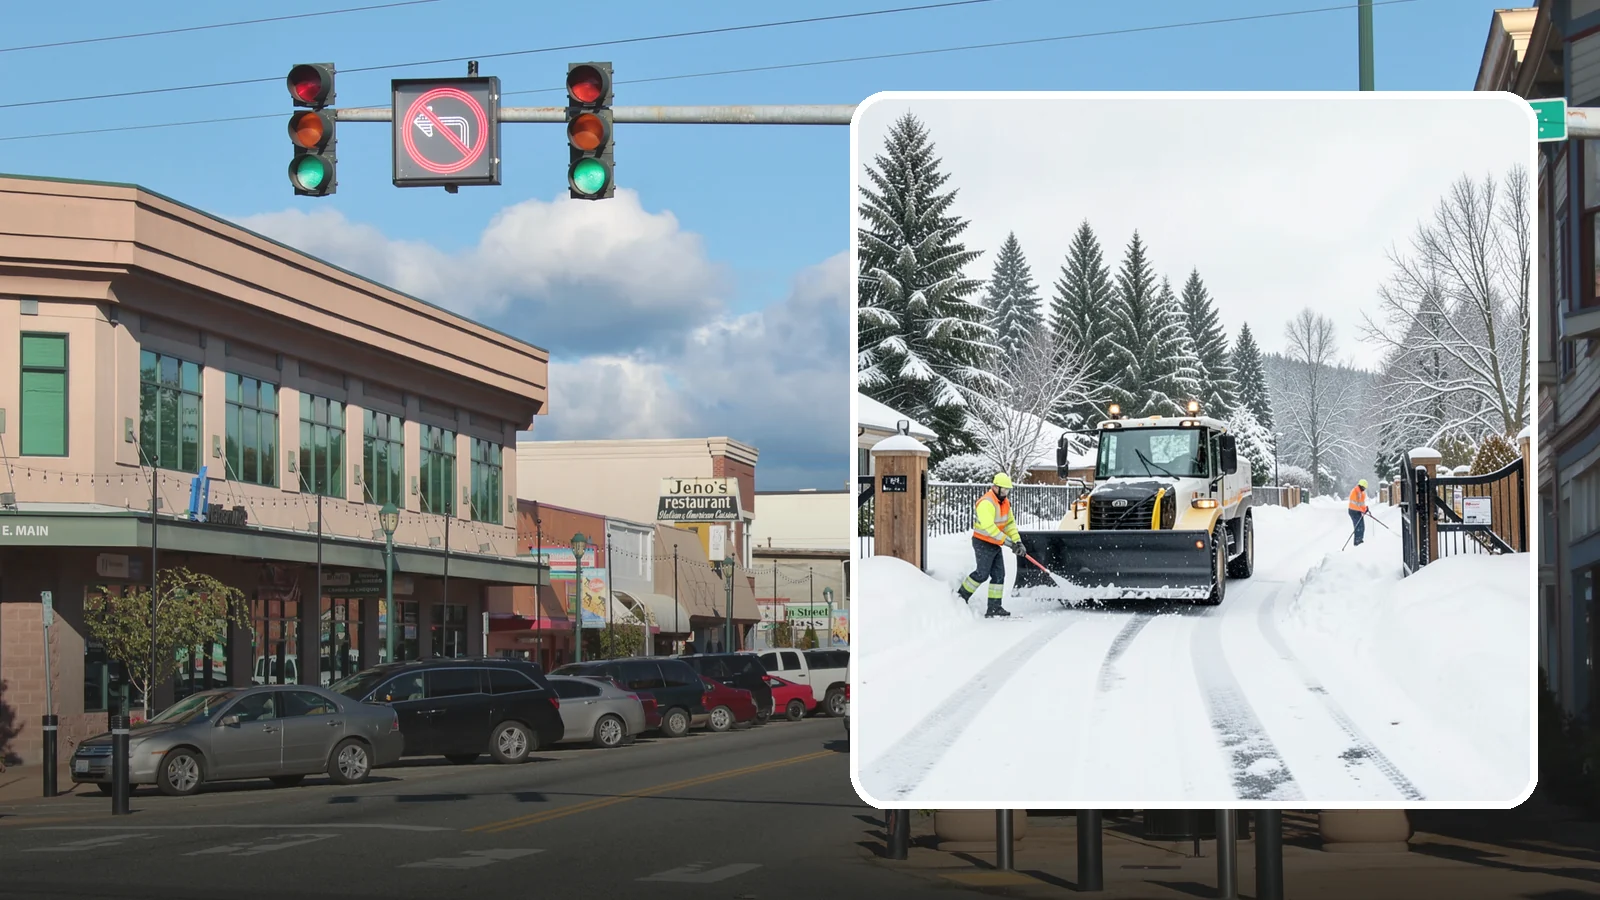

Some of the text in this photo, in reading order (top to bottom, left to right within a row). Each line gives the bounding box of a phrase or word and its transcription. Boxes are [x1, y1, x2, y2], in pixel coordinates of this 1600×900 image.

[670, 480, 728, 495] Jeno's
[665, 496, 731, 509] restaurant
[659, 510, 682, 520] Italian
[686, 510, 715, 519] American
[715, 510, 738, 520] Cuisine
[2, 525, 49, 536] E. MAIN
[797, 607, 828, 617] Street
[790, 619, 824, 627] lass
